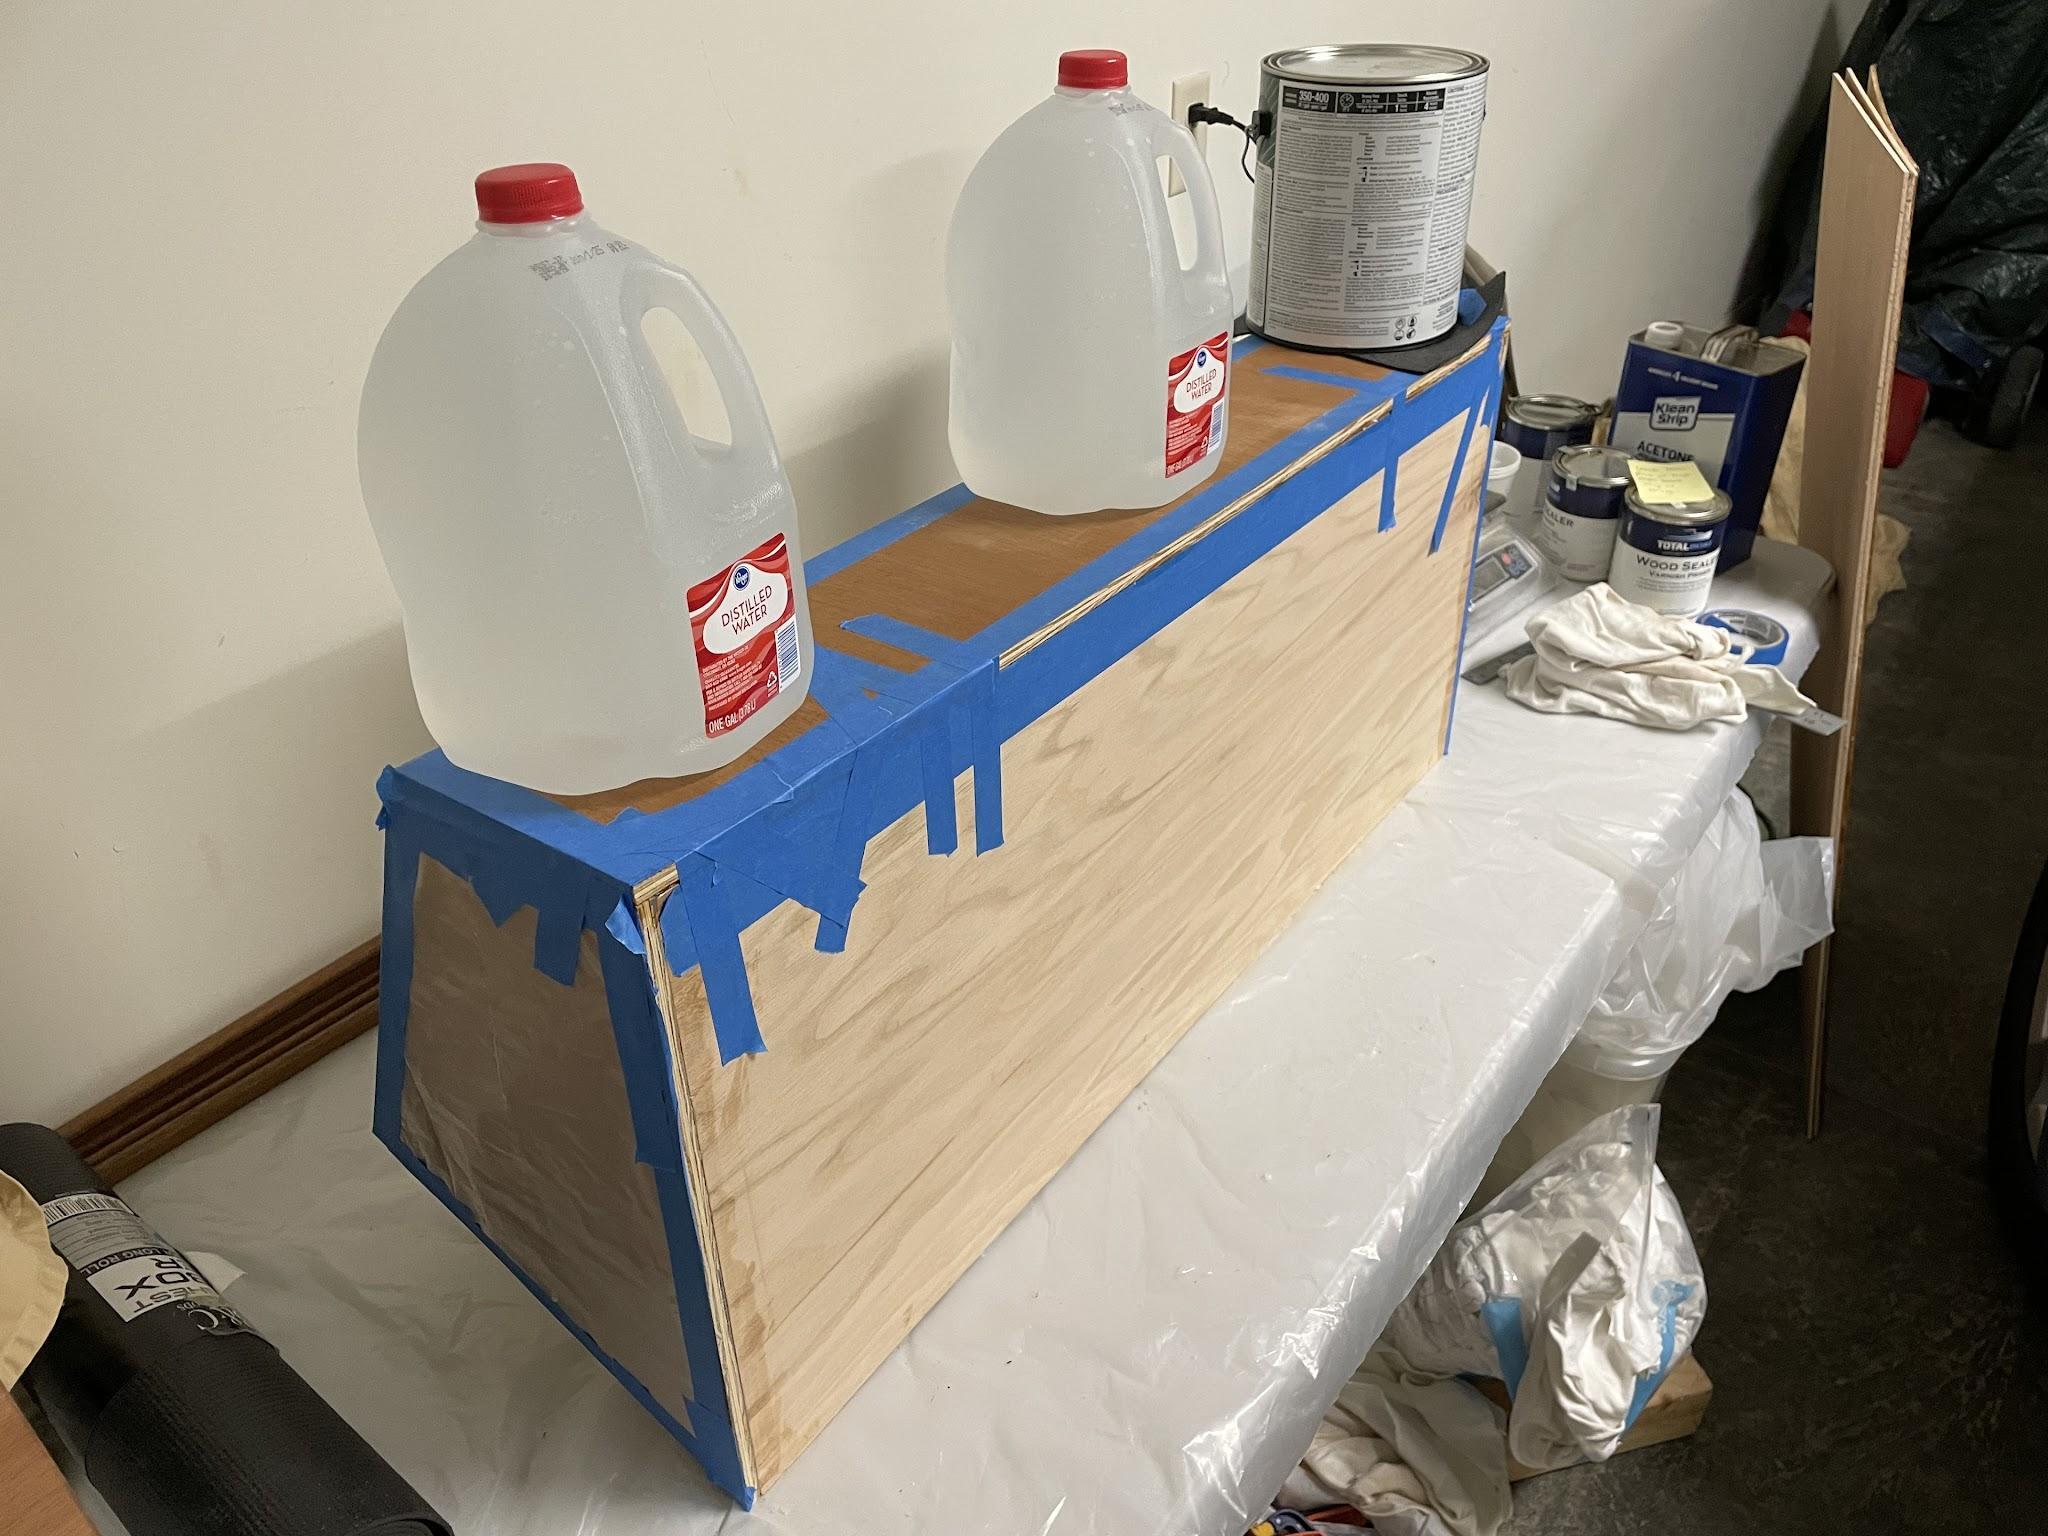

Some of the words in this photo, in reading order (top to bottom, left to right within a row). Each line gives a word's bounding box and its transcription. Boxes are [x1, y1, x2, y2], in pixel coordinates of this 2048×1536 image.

[1299, 90, 1330, 103] 350-400
[1186, 368, 1217, 393] DISTILLED
[1191, 382, 1212, 401] WATER
[1655, 403, 1695, 414] Klean
[1657, 413, 1688, 426] Strip
[1636, 554, 1678, 571] WOOD
[721, 585, 773, 627] DISTILLED
[731, 604, 768, 635] WATER
[708, 717, 724, 733] ONE
[724, 711, 738, 727] GAL
[122, 1247, 160, 1259] LONG
[79, 1254, 120, 1276] ROLL
